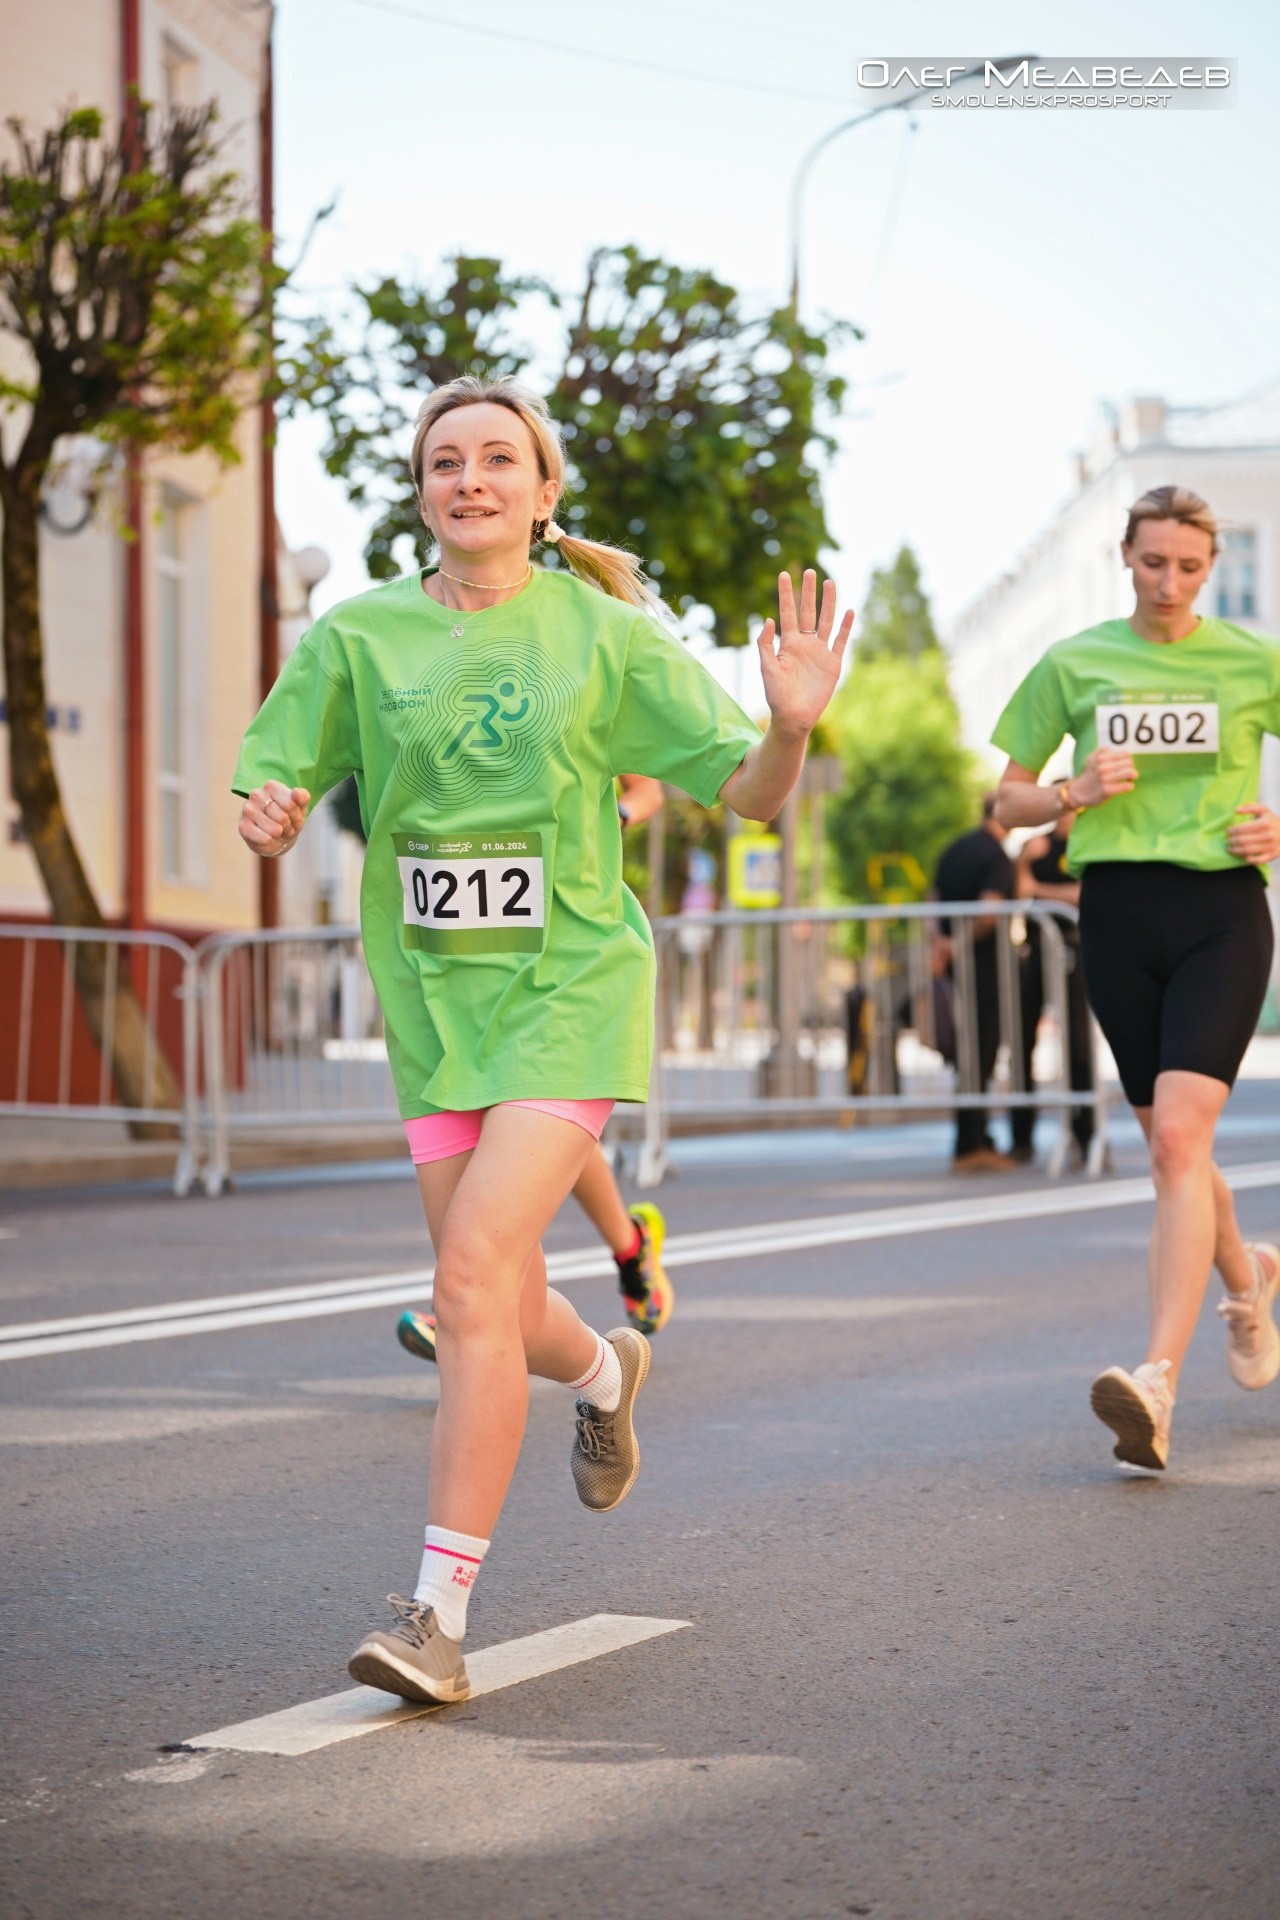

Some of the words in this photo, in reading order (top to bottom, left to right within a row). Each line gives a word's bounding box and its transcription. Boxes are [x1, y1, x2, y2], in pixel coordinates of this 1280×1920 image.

[1109, 712, 1206, 745] 0602
[482, 842, 527, 851] 01.06.2024
[412, 868, 531, 918] 0212
